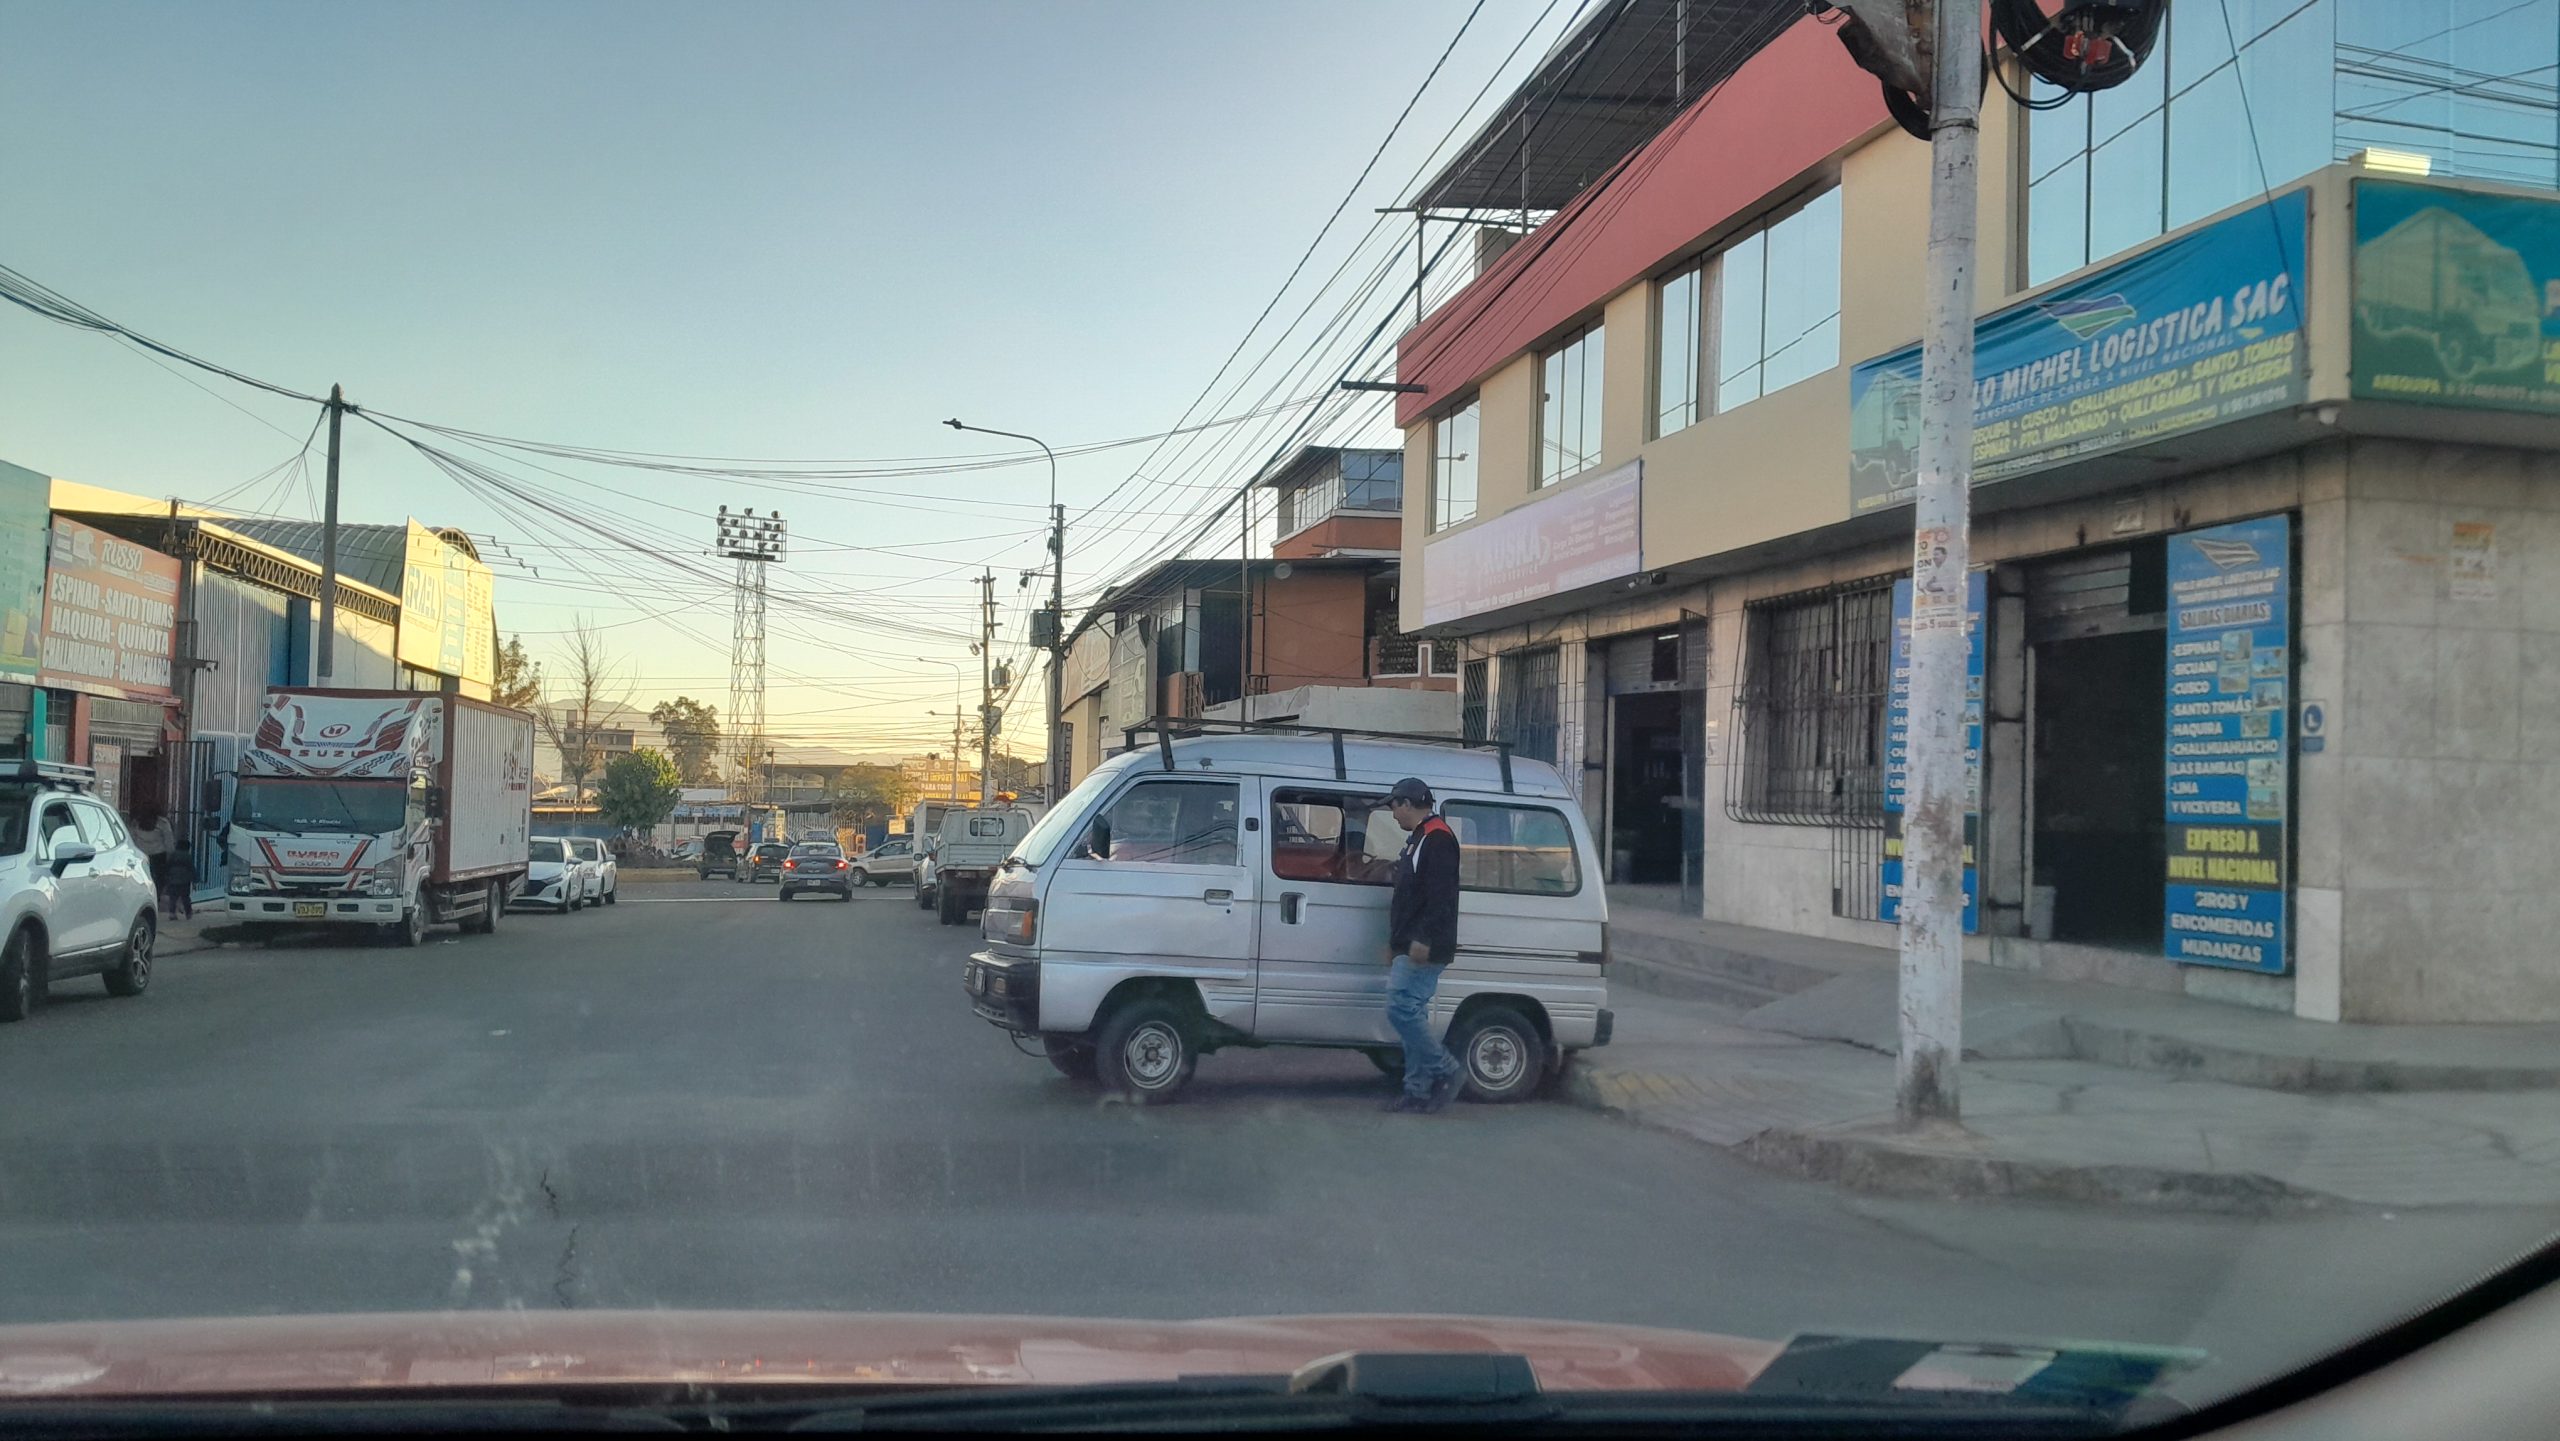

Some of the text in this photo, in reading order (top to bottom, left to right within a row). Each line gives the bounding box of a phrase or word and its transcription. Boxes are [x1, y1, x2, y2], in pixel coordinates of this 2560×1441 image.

[1972, 271, 2289, 411] LO MICHEL LOGISTICA SAC
[1972, 420, 2011, 446] REQUIPA
[2021, 406, 2059, 430] CUSCO
[2191, 350, 2240, 380] SANTO
[2243, 332, 2296, 366] TOMAS
[1973, 397, 2035, 422] RANSPORTE
[2059, 377, 2100, 398] CARGA
[2119, 361, 2155, 378] NIVEL
[2162, 332, 2234, 365] NACIONAL
[2044, 409, 2109, 443] MALDONADO
[2120, 382, 2201, 423] QUILLABAMBA
[2207, 376, 2218, 398] Y
[2219, 355, 2293, 394] VICEVERSA
[101, 539, 143, 572] RUSSO
[51, 572, 100, 611] ESPINAR
[140, 595, 174, 628] TOMAS
[2181, 602, 2267, 628] SALIDAS DIARIAS
[117, 622, 169, 655] QUIÑOTA
[2212, 696, 2253, 715] TOMÁS
[920, 783, 953, 791] PARA TODO
[2172, 801, 2242, 815] Y VICEVERSA
[2186, 828, 2259, 853] EXPRESO A
[2167, 856, 2279, 884] NIVEL NACIONAL
[2238, 895, 2249, 911] Y
[2171, 913, 2274, 939] ENCOMIENDAS
[2181, 938, 2263, 964] MUDANZAS
